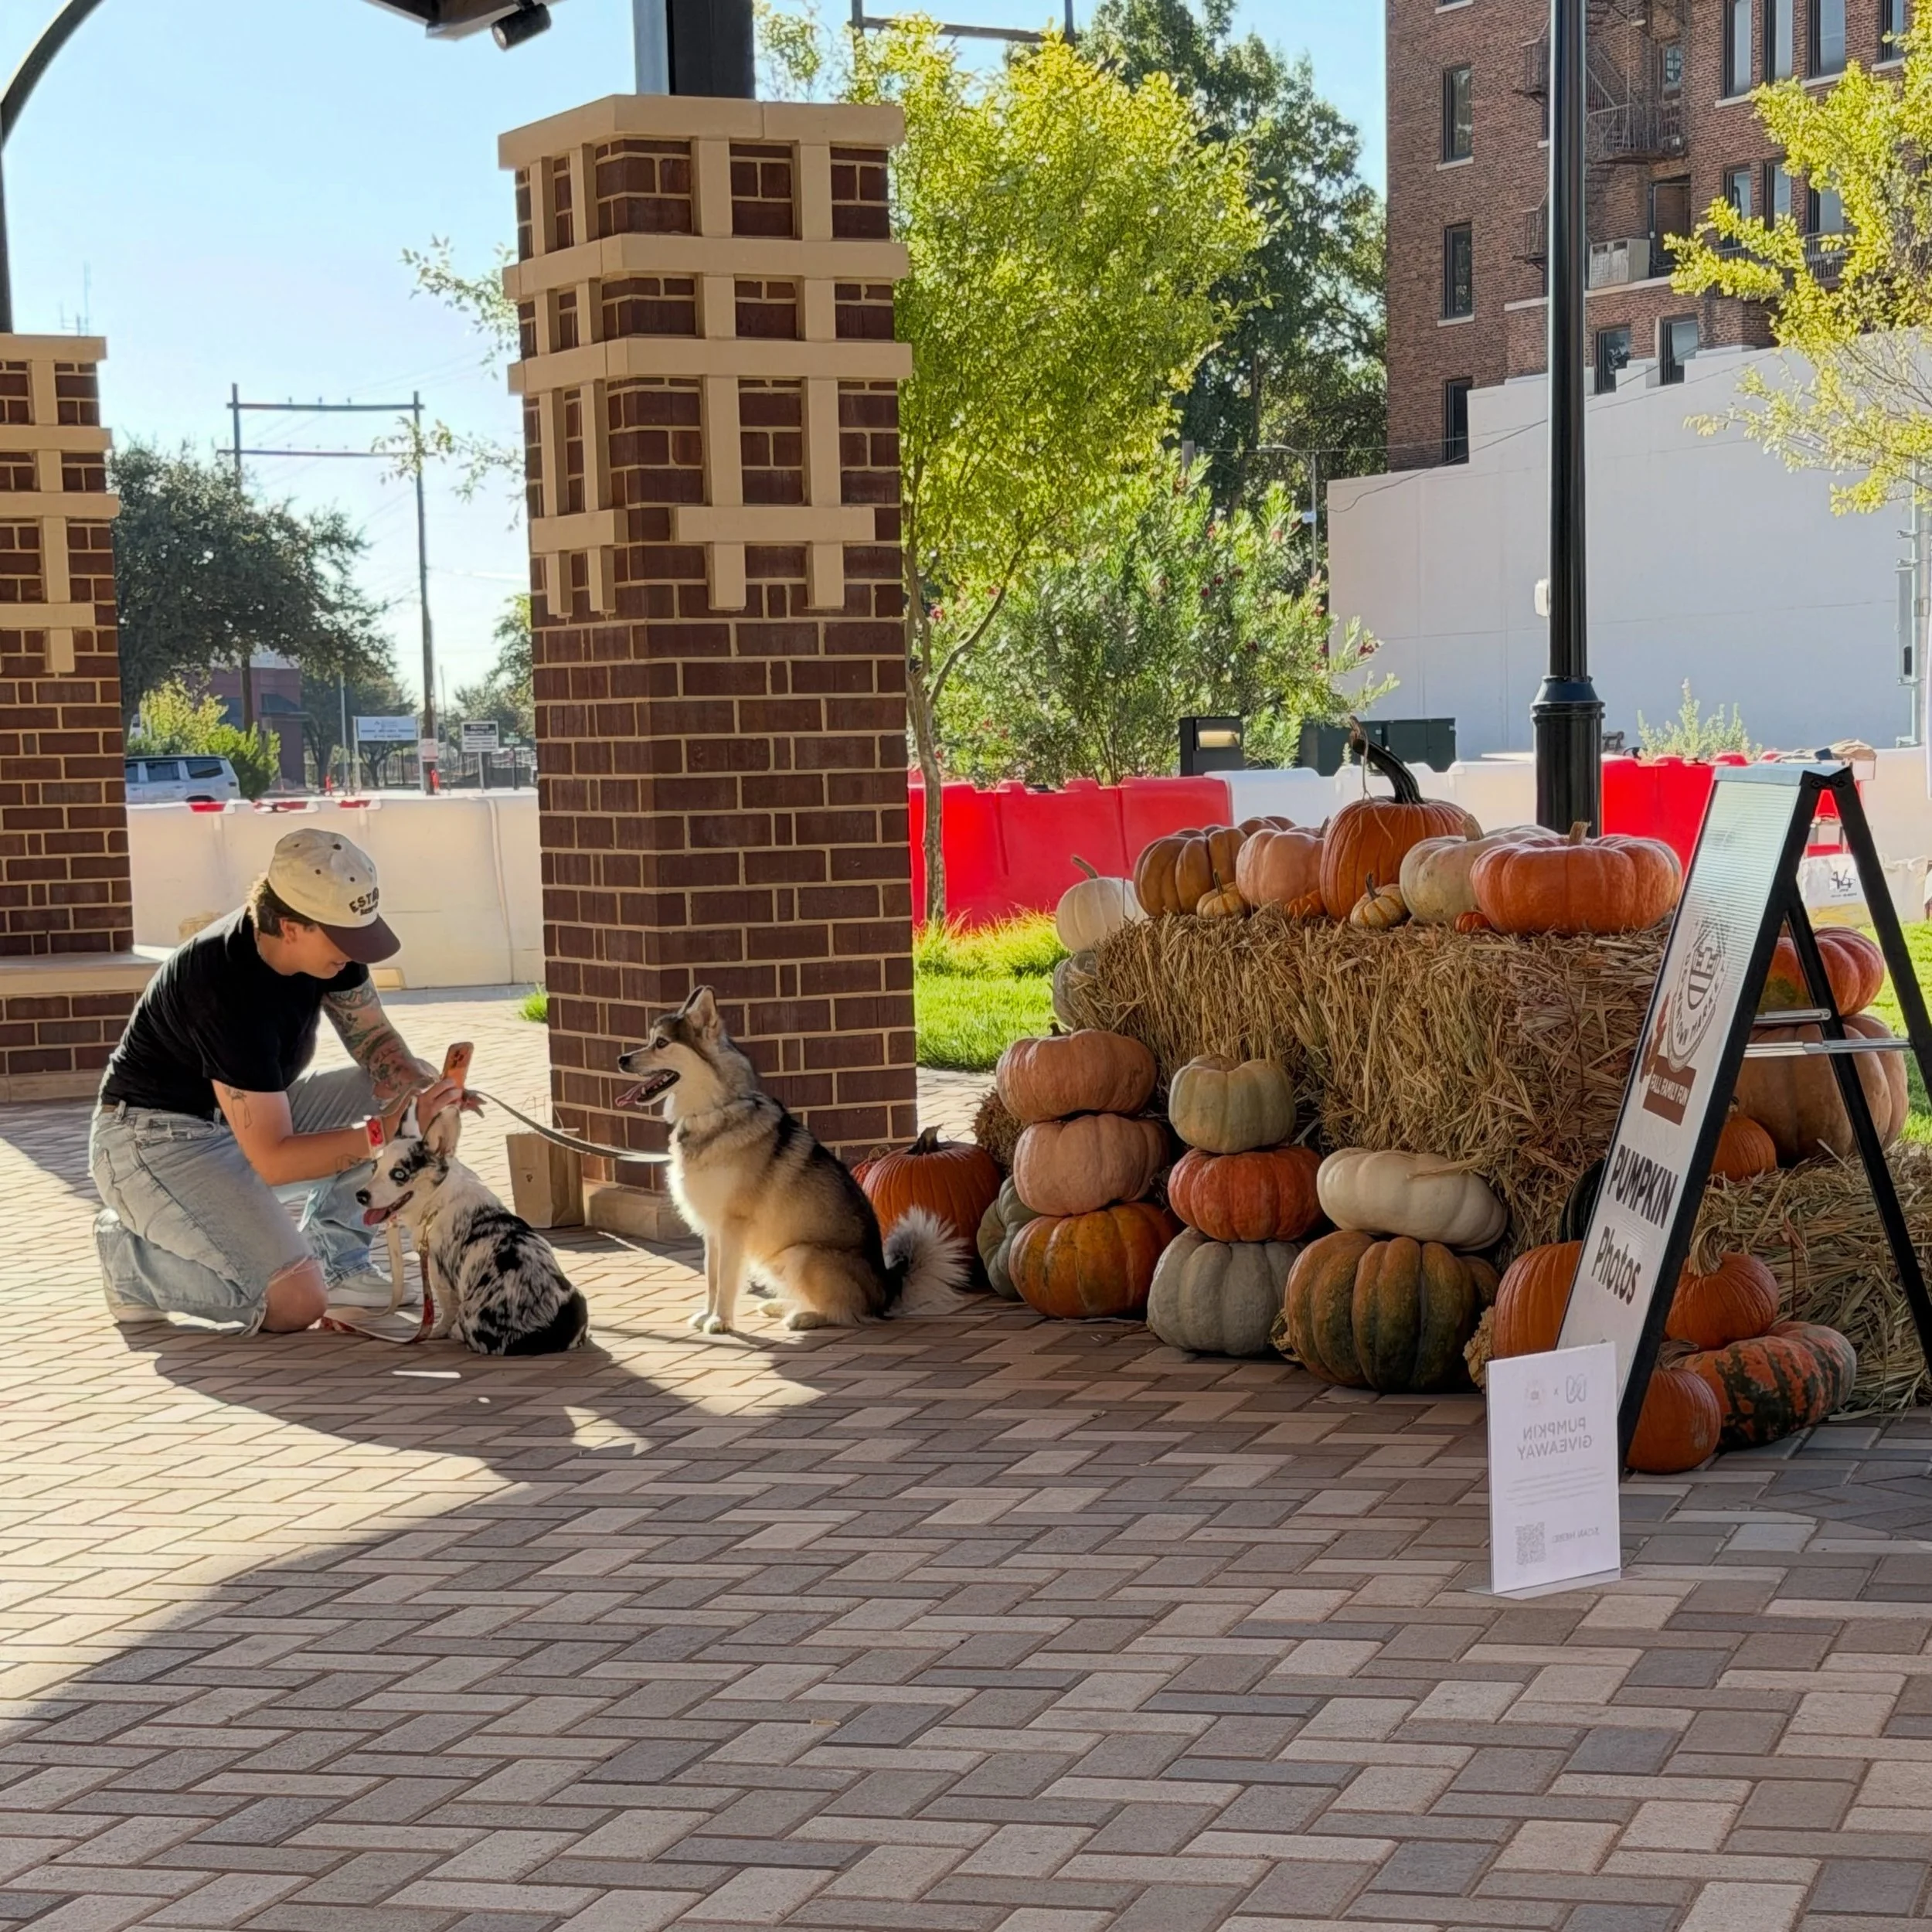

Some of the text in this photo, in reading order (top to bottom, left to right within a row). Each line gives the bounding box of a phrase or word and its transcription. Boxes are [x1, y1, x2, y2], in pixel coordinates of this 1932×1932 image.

[1649, 1073, 1689, 1106] FALL FAMILY FUN
[1607, 1145, 1679, 1230] PUMPKIN
[1591, 1226, 1641, 1305] Photos
